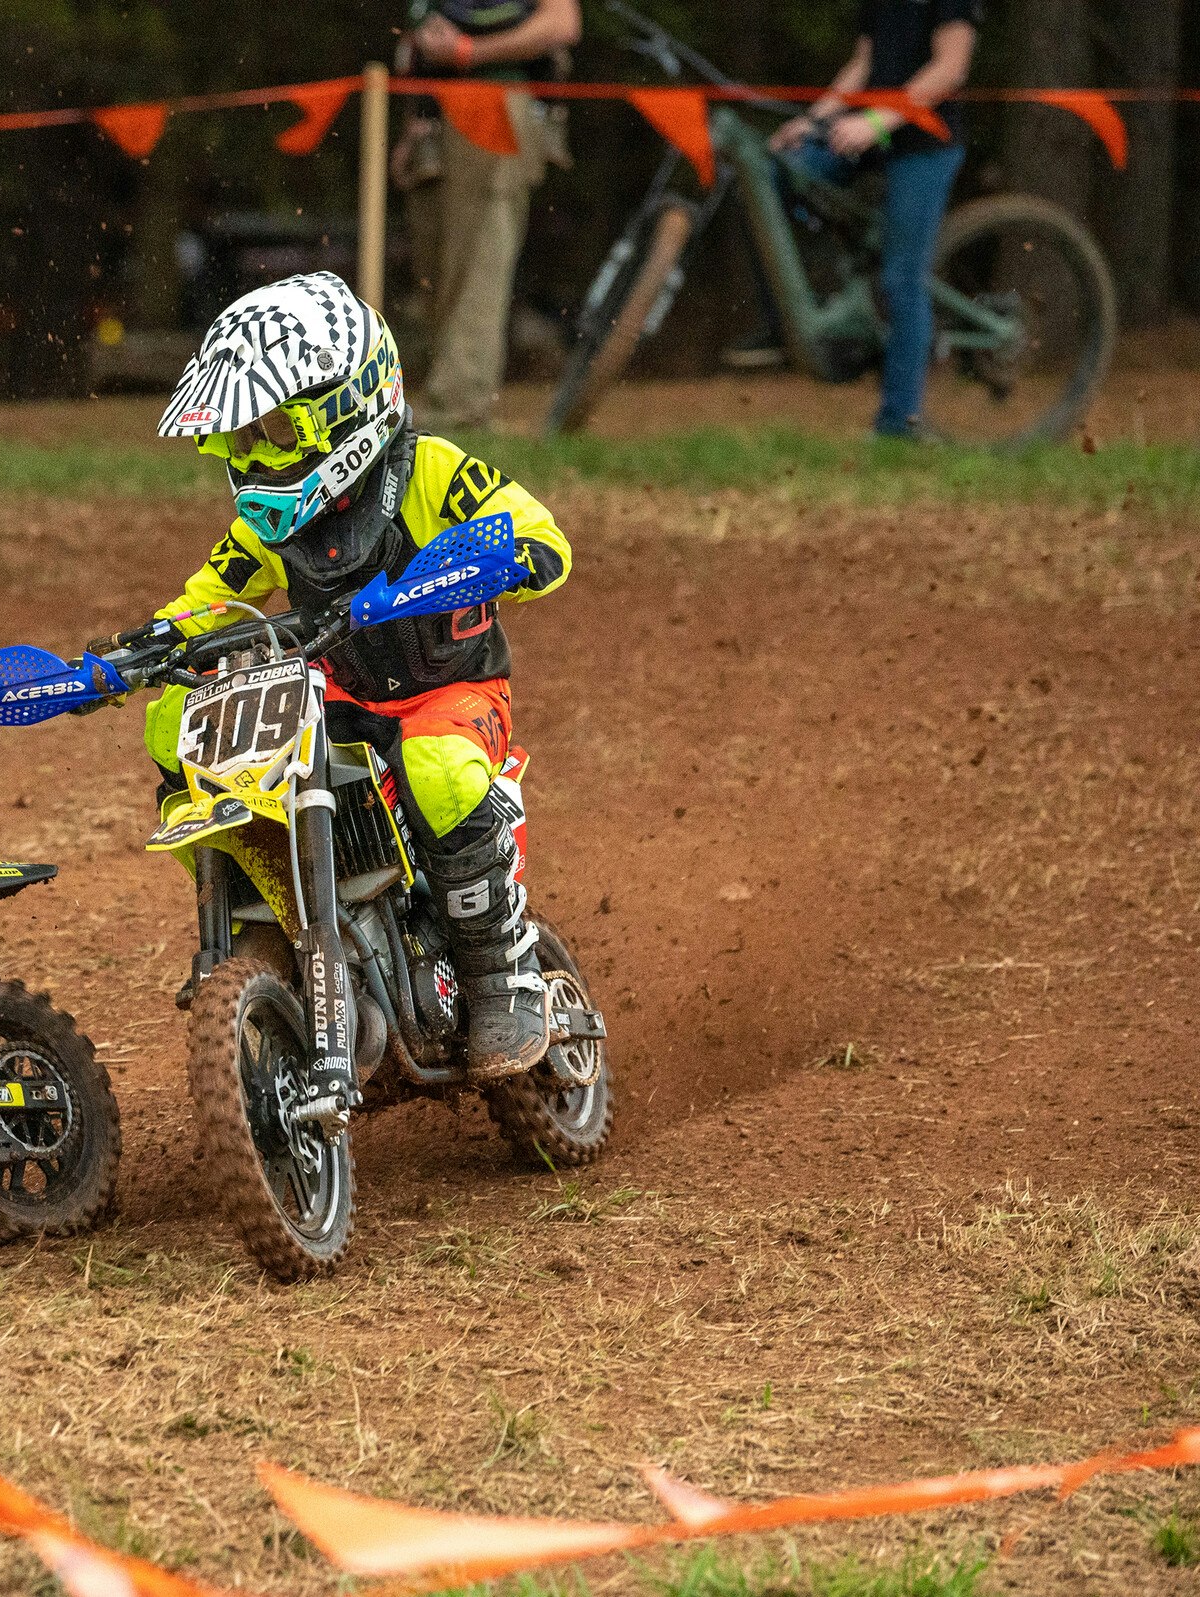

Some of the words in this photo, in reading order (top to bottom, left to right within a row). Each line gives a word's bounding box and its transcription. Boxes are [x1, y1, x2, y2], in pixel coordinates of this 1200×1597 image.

[319, 338, 395, 427] 100%
[180, 411, 212, 423] BELL
[294, 416, 308, 443] 100%
[330, 437, 373, 484] 309
[248, 662, 302, 684] COBRA
[186, 680, 231, 707] SOLLON
[184, 679, 304, 769] 309
